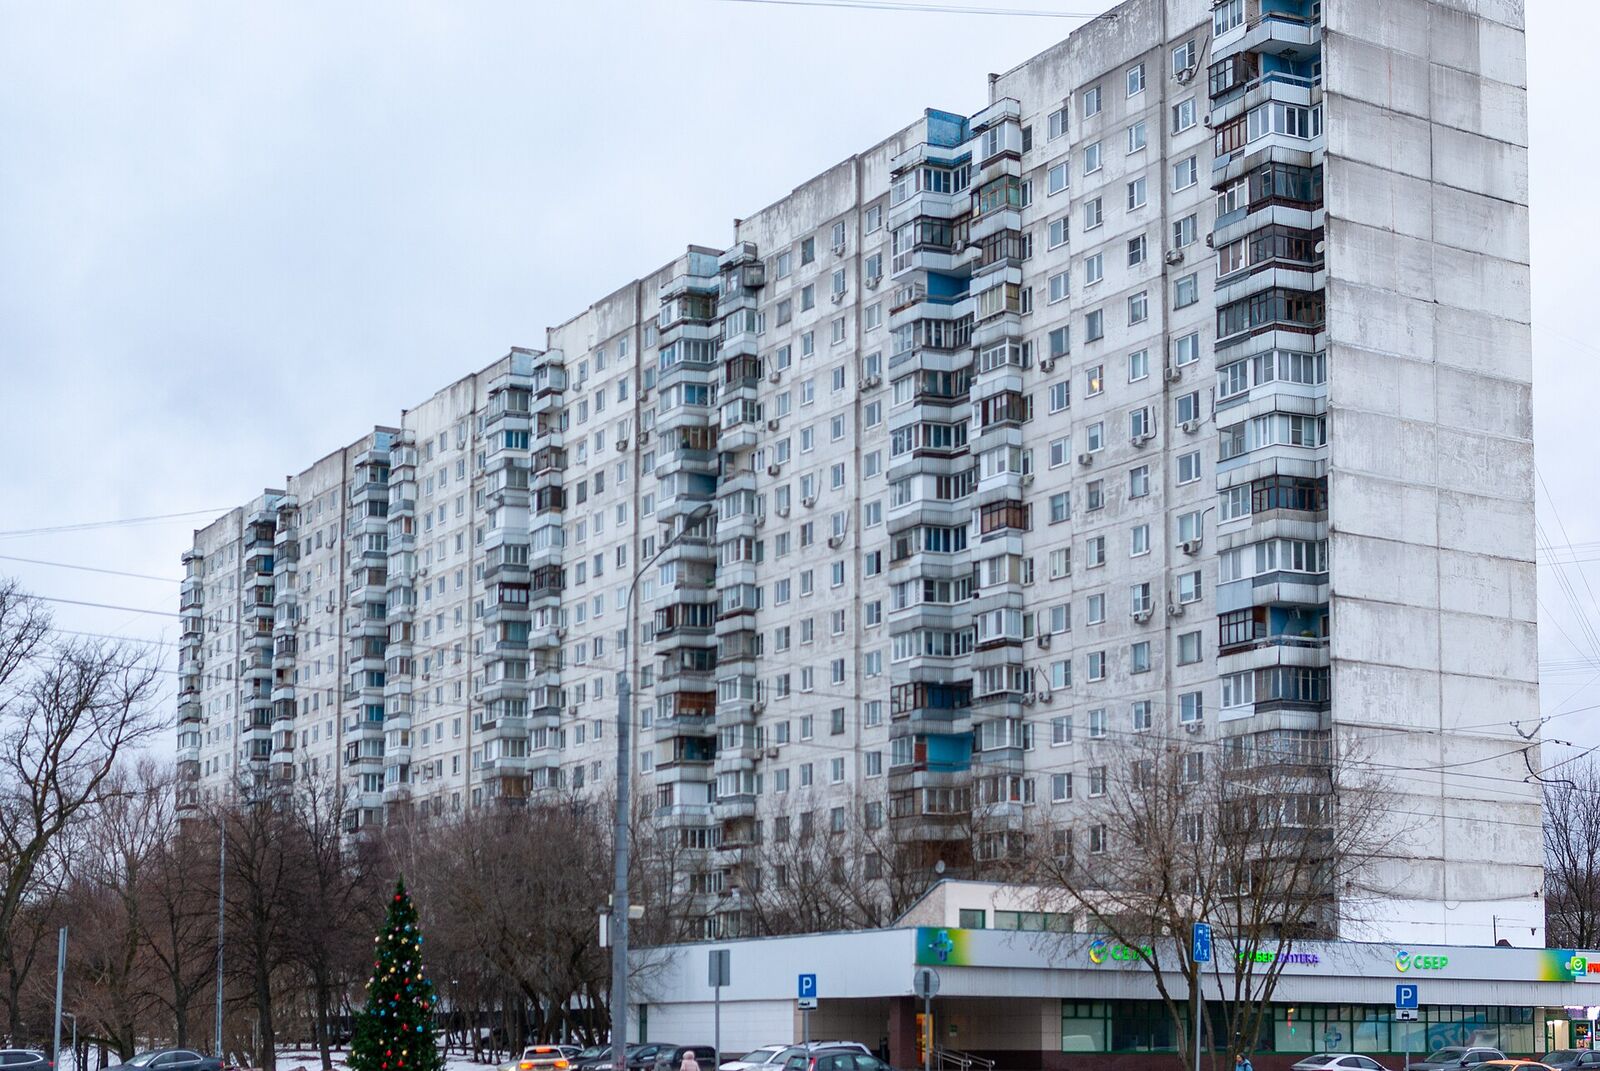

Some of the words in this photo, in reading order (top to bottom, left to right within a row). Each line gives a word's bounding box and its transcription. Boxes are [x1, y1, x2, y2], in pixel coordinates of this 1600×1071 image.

[1413, 955, 1449, 969] СБЕР
[802, 976, 813, 995] P
[1401, 987, 1412, 1005] P
